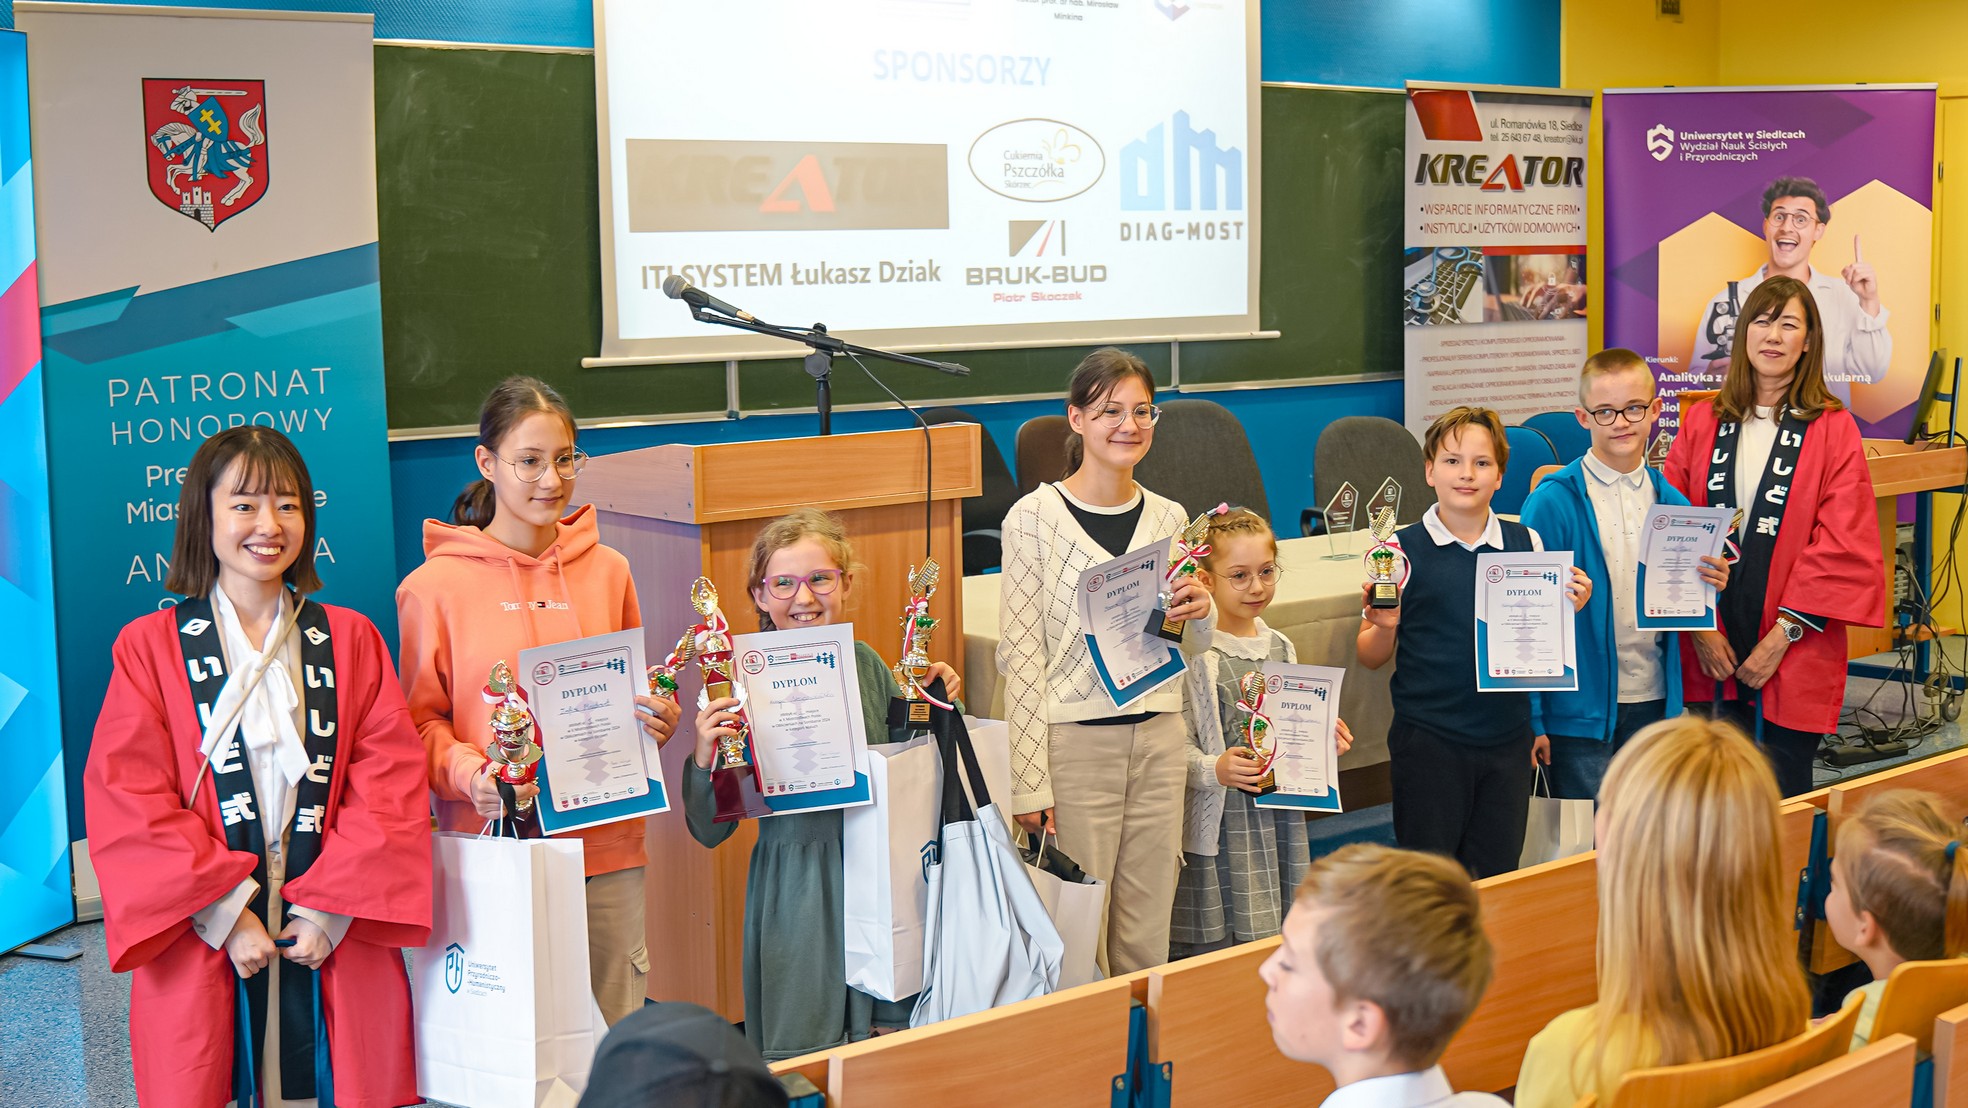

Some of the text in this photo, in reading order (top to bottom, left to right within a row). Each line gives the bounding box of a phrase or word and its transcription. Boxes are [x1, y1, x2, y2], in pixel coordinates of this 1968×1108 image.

[873, 49, 1052, 86] SPONSORZY
[1501, 118, 1547, 130] Romanówka
[1680, 131, 1743, 142] Uniwersytet
[1756, 130, 1805, 140] Siedlcach
[1680, 139, 1787, 153] Wydział Nauk Ścisłych
[1004, 150, 1043, 161] Cukiernia
[1685, 152, 1758, 163] Przyrodniczych
[1004, 163, 1065, 178] Pszczółka
[1415, 154, 1584, 192] KREATOR
[1475, 204, 1553, 215] INFORMATYCZNE
[1120, 222, 1243, 241] DIAG-MOST
[682, 263, 782, 289] SYSTEM
[791, 262, 870, 286] Łukasz
[879, 258, 942, 284] Dziak
[966, 265, 1107, 286] BRUK-BUD
[993, 290, 1083, 303] Piotr Skoczek
[1658, 373, 1713, 384] Analityka
[108, 366, 332, 408] PATRONAT
[1756, 429, 1801, 537] いしど式
[1106, 580, 1140, 599] DYPLOM
[546, 600, 568, 610] Jean
[772, 676, 817, 689] DYPLOM
[562, 683, 607, 699] DYPLOM
[1281, 702, 1311, 711] DYPLOM
[296, 664, 336, 834] いしど式
